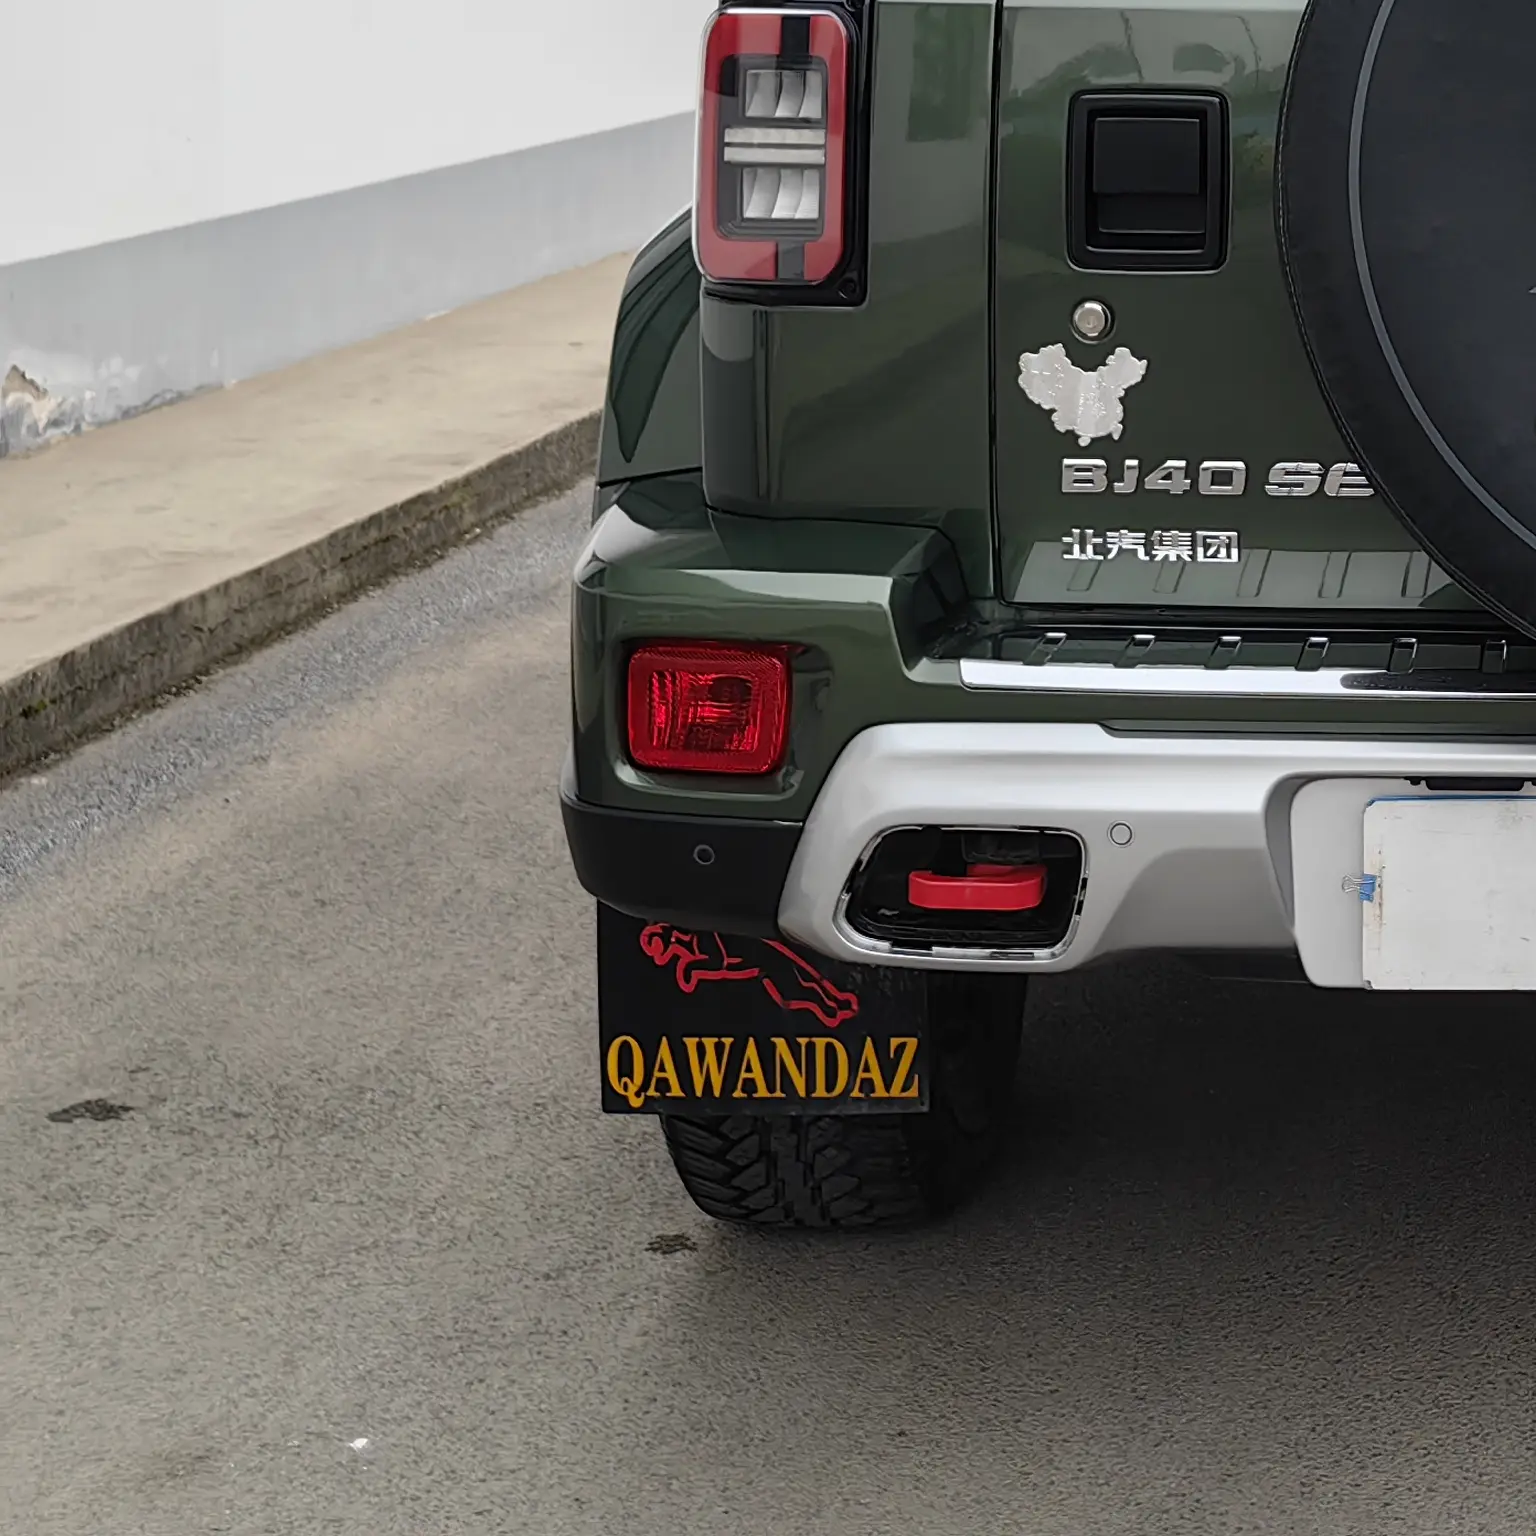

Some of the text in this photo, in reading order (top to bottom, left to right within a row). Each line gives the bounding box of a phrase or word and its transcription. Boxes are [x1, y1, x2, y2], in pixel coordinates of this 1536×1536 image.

[1061, 458, 1375, 497] BJ40 SE
[1061, 528, 1241, 562] 北汽集团
[606, 1035, 919, 1107] QAWANDAZ
